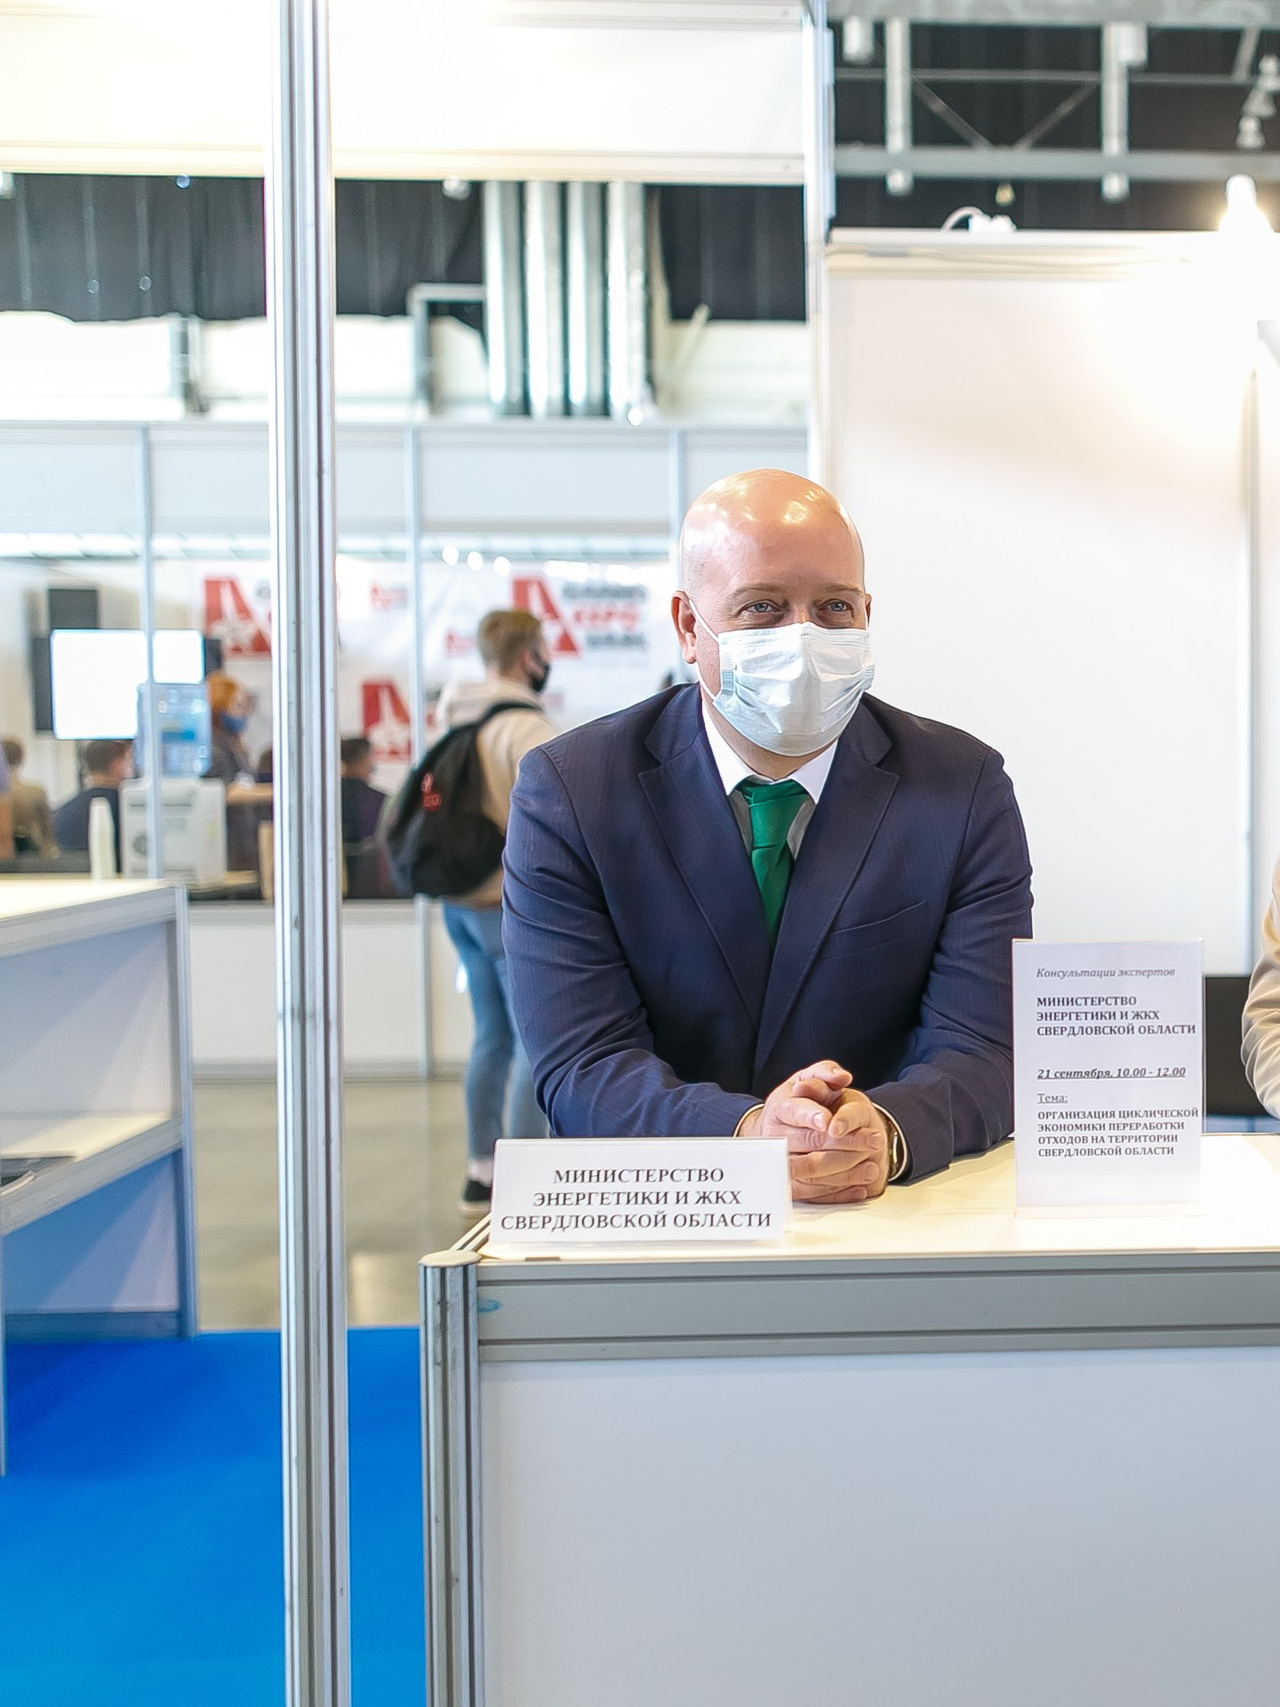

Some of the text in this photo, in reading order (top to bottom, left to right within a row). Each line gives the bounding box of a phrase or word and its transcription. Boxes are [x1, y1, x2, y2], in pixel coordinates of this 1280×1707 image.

[1036, 968, 1176, 980] Консультации экспертов
[1036, 997, 1137, 1007] МИНИСТЕРСТВО
[1036, 1010, 1160, 1021] ЭНЕРГЕТИКИ И ЖКХ
[1037, 1023, 1196, 1037] СВЕРДЛОВСКОЙ ОБЛАСТИ
[1038, 1069, 1051, 1079] 21
[1053, 1068, 1115, 1079] сентября,
[1116, 1068, 1148, 1078] 10.00
[1156, 1067, 1186, 1078] 12.00
[1036, 1093, 1069, 1104] Тема:
[1037, 1108, 1199, 1121] ОРГАНИЗАЦИЯ ЦИКЛИЧЕСКОЙ
[1037, 1122, 1185, 1132] ЭКОНОМИКИ ПЕРЕРАБОТКИ
[1038, 1136, 1089, 1145] ОТХОДОВ
[1109, 1135, 1178, 1144] ТЕРРИТОРИИ
[1038, 1146, 1175, 1157] СВЕРДЛОВСКОЙ ОБЛАСТИ
[554, 1168, 725, 1184] МИНИСТЕРСТВО
[533, 1190, 741, 1207] ЭНЕРГЕТИКИ И ЖКХ
[500, 1210, 771, 1233] СВЕРДЛОВСКОЙ ОБЛАСТИ
